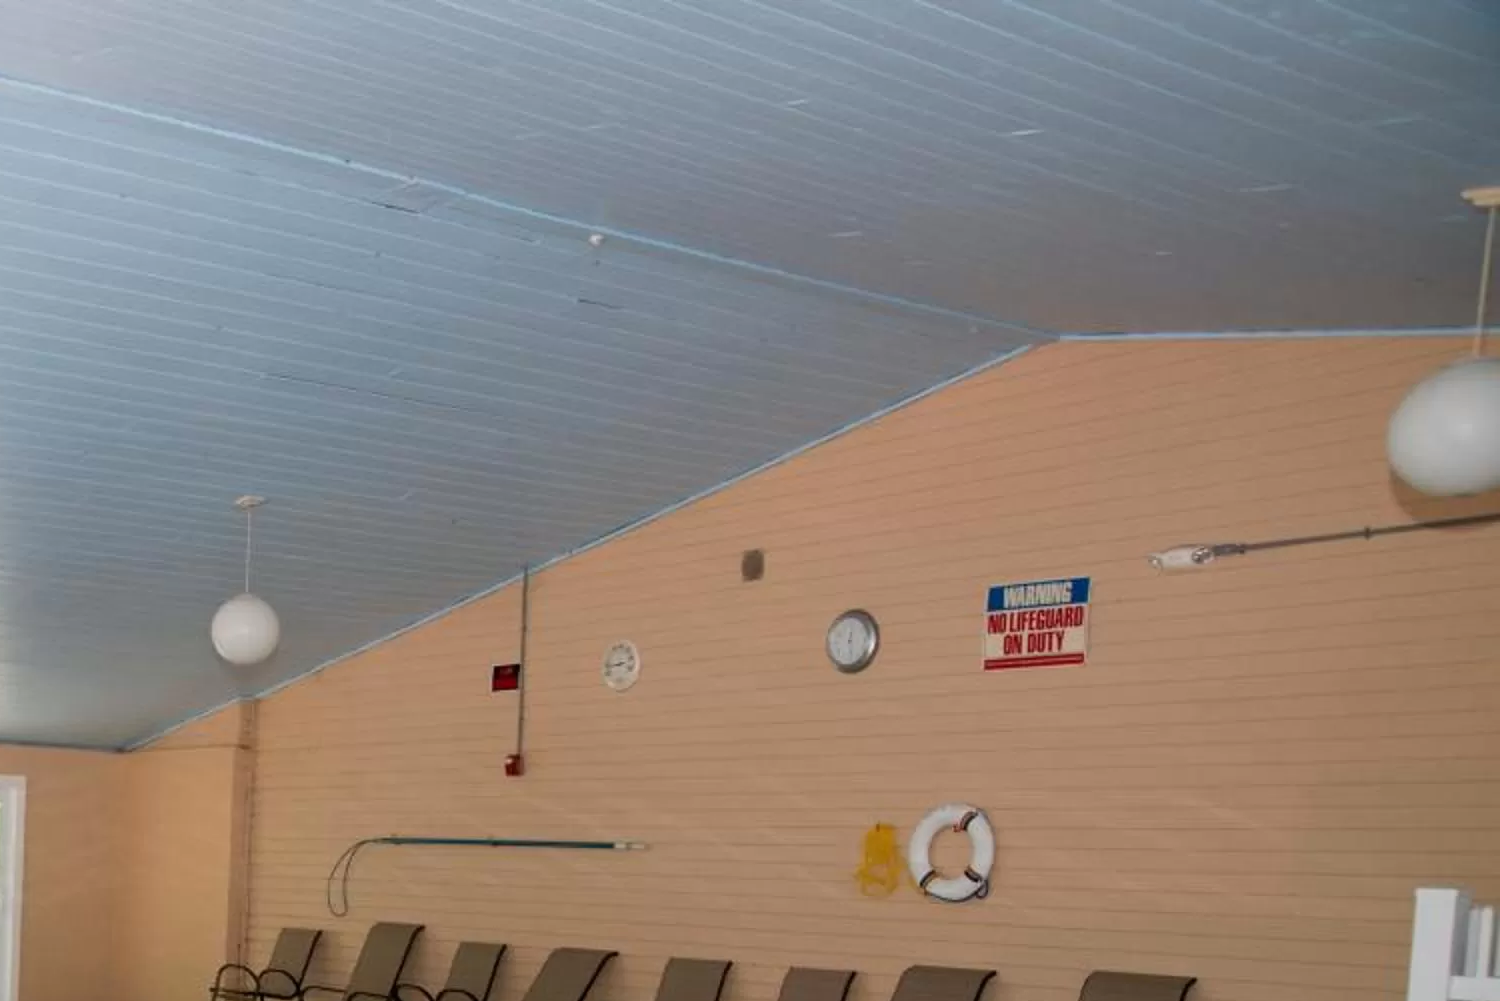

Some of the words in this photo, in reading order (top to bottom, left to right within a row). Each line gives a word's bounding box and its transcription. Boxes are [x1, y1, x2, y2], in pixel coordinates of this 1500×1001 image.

[1003, 581, 1072, 609] WARNING
[987, 613, 1007, 635] NO
[1009, 605, 1084, 633] LIFEGUARD
[1003, 633, 1022, 655] ON
[1027, 631, 1065, 653] DUTY
